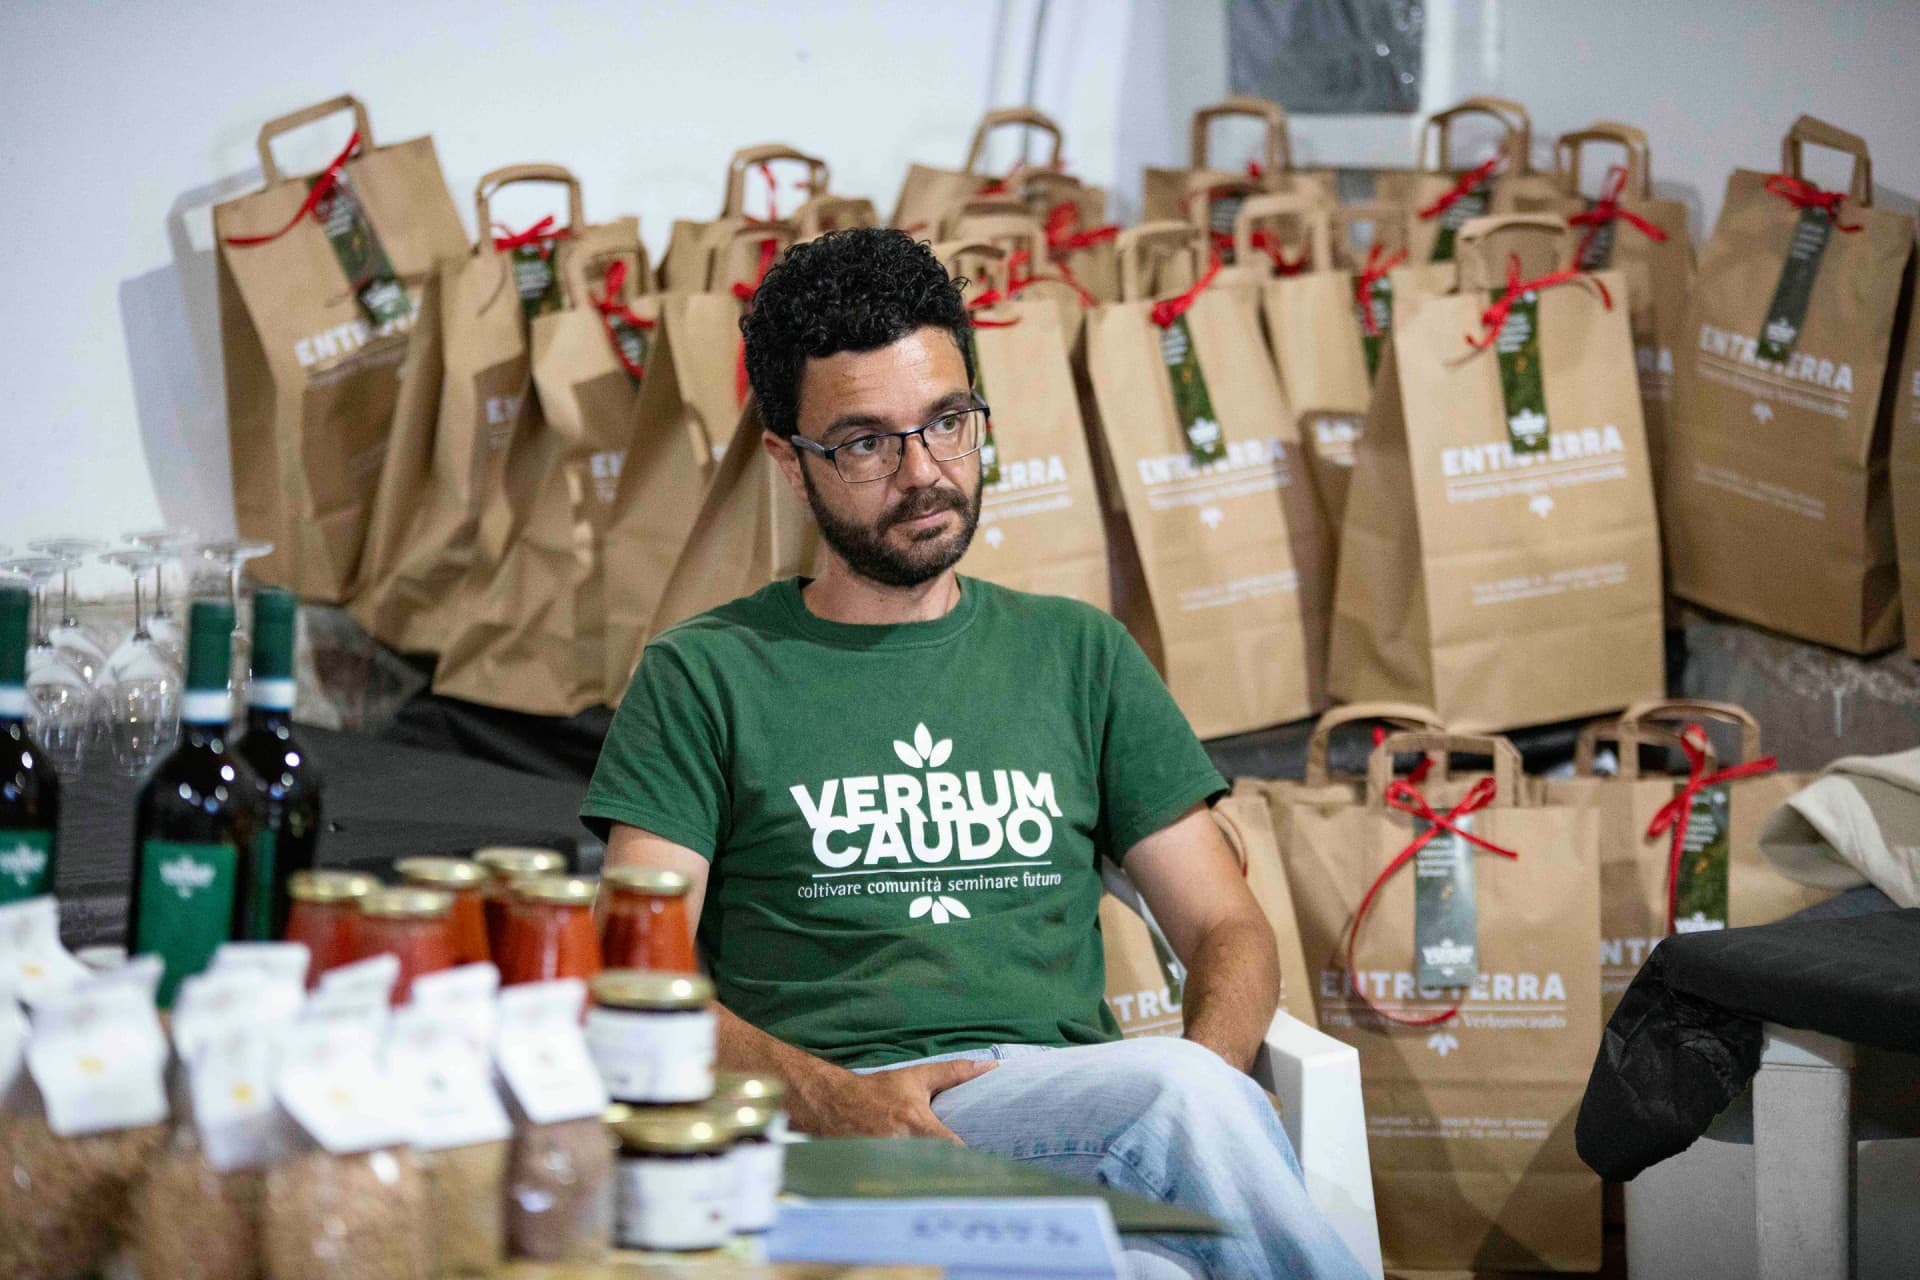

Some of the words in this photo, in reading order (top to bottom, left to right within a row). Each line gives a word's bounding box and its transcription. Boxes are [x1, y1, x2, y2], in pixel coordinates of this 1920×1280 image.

[1699, 323, 1854, 393] ENTRERRA
[1441, 424, 1624, 476] ENTRERRA
[789, 769, 1063, 830] VERBUM
[812, 807, 1054, 868] CAUDO
[797, 883, 862, 899] coltivare
[867, 876, 942, 894] comunità
[947, 874, 1019, 891] seminare
[1023, 871, 1062, 888] futuro
[1320, 970, 1567, 1000] ENTRERRA
